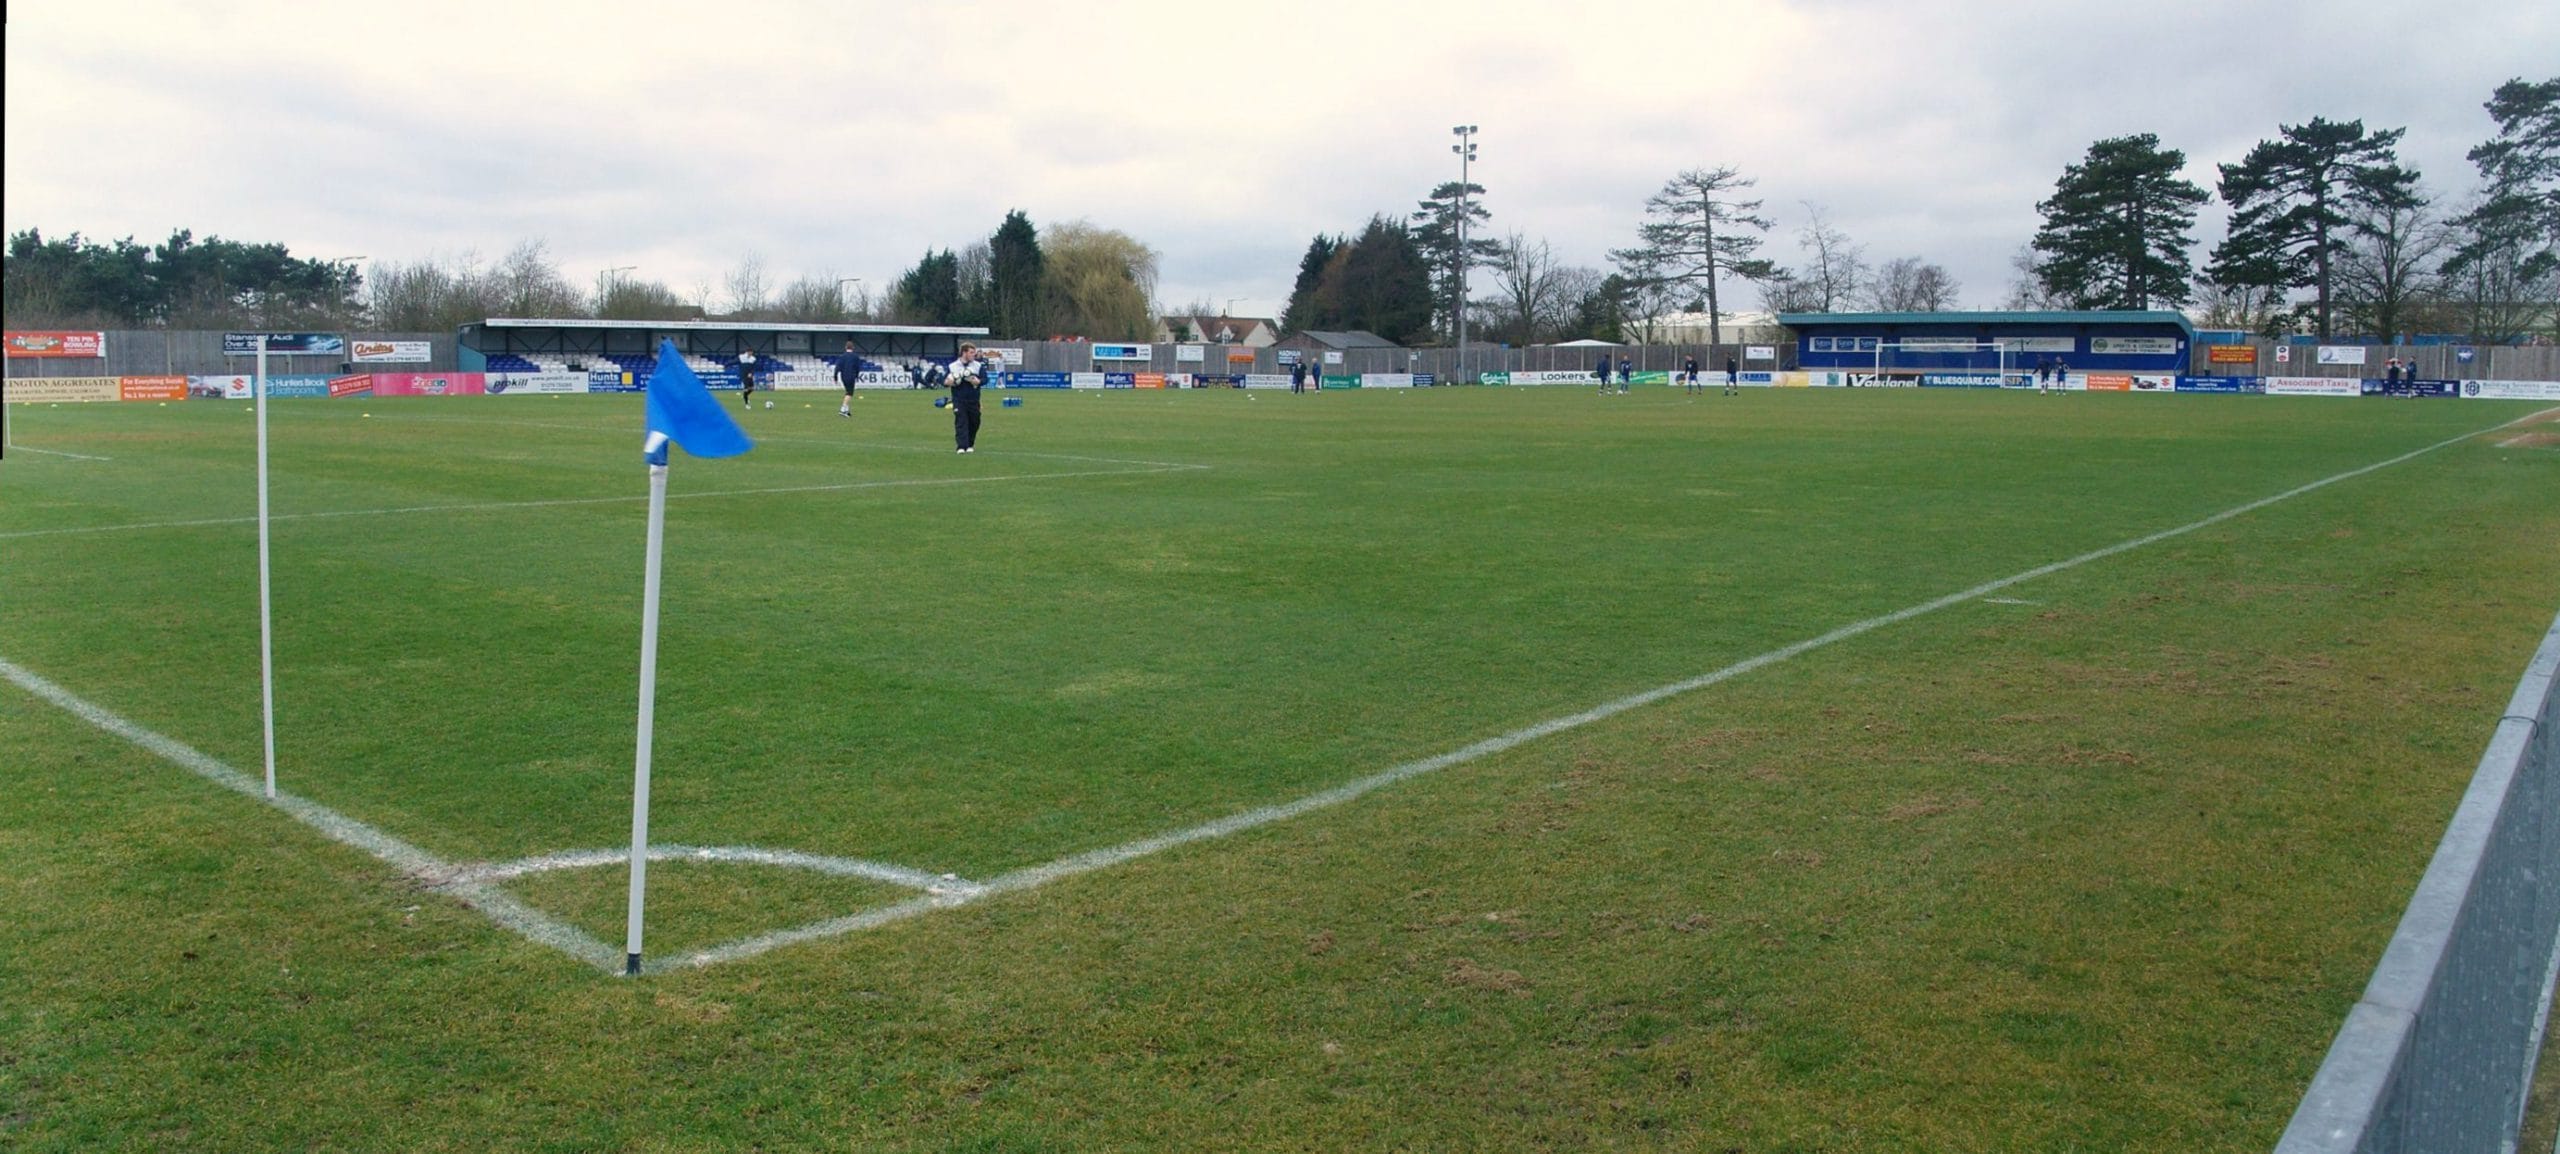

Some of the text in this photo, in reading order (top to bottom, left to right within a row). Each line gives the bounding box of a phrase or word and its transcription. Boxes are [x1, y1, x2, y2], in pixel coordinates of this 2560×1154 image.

[589, 372, 619, 381] Hunts
[776, 372, 836, 382] Tamarind Tre
[855, 372, 912, 384] K&B kitch
[1541, 372, 1586, 381] Lookers
[1849, 373, 1920, 388] Vadanel
[49, 379, 117, 388] AGGREGATES
[135, 378, 164, 386] Everything
[275, 378, 304, 387] Hunters
[304, 378, 326, 387] Brook
[493, 378, 529, 390] prokill
[2276, 378, 2349, 388] Associated Taxis
